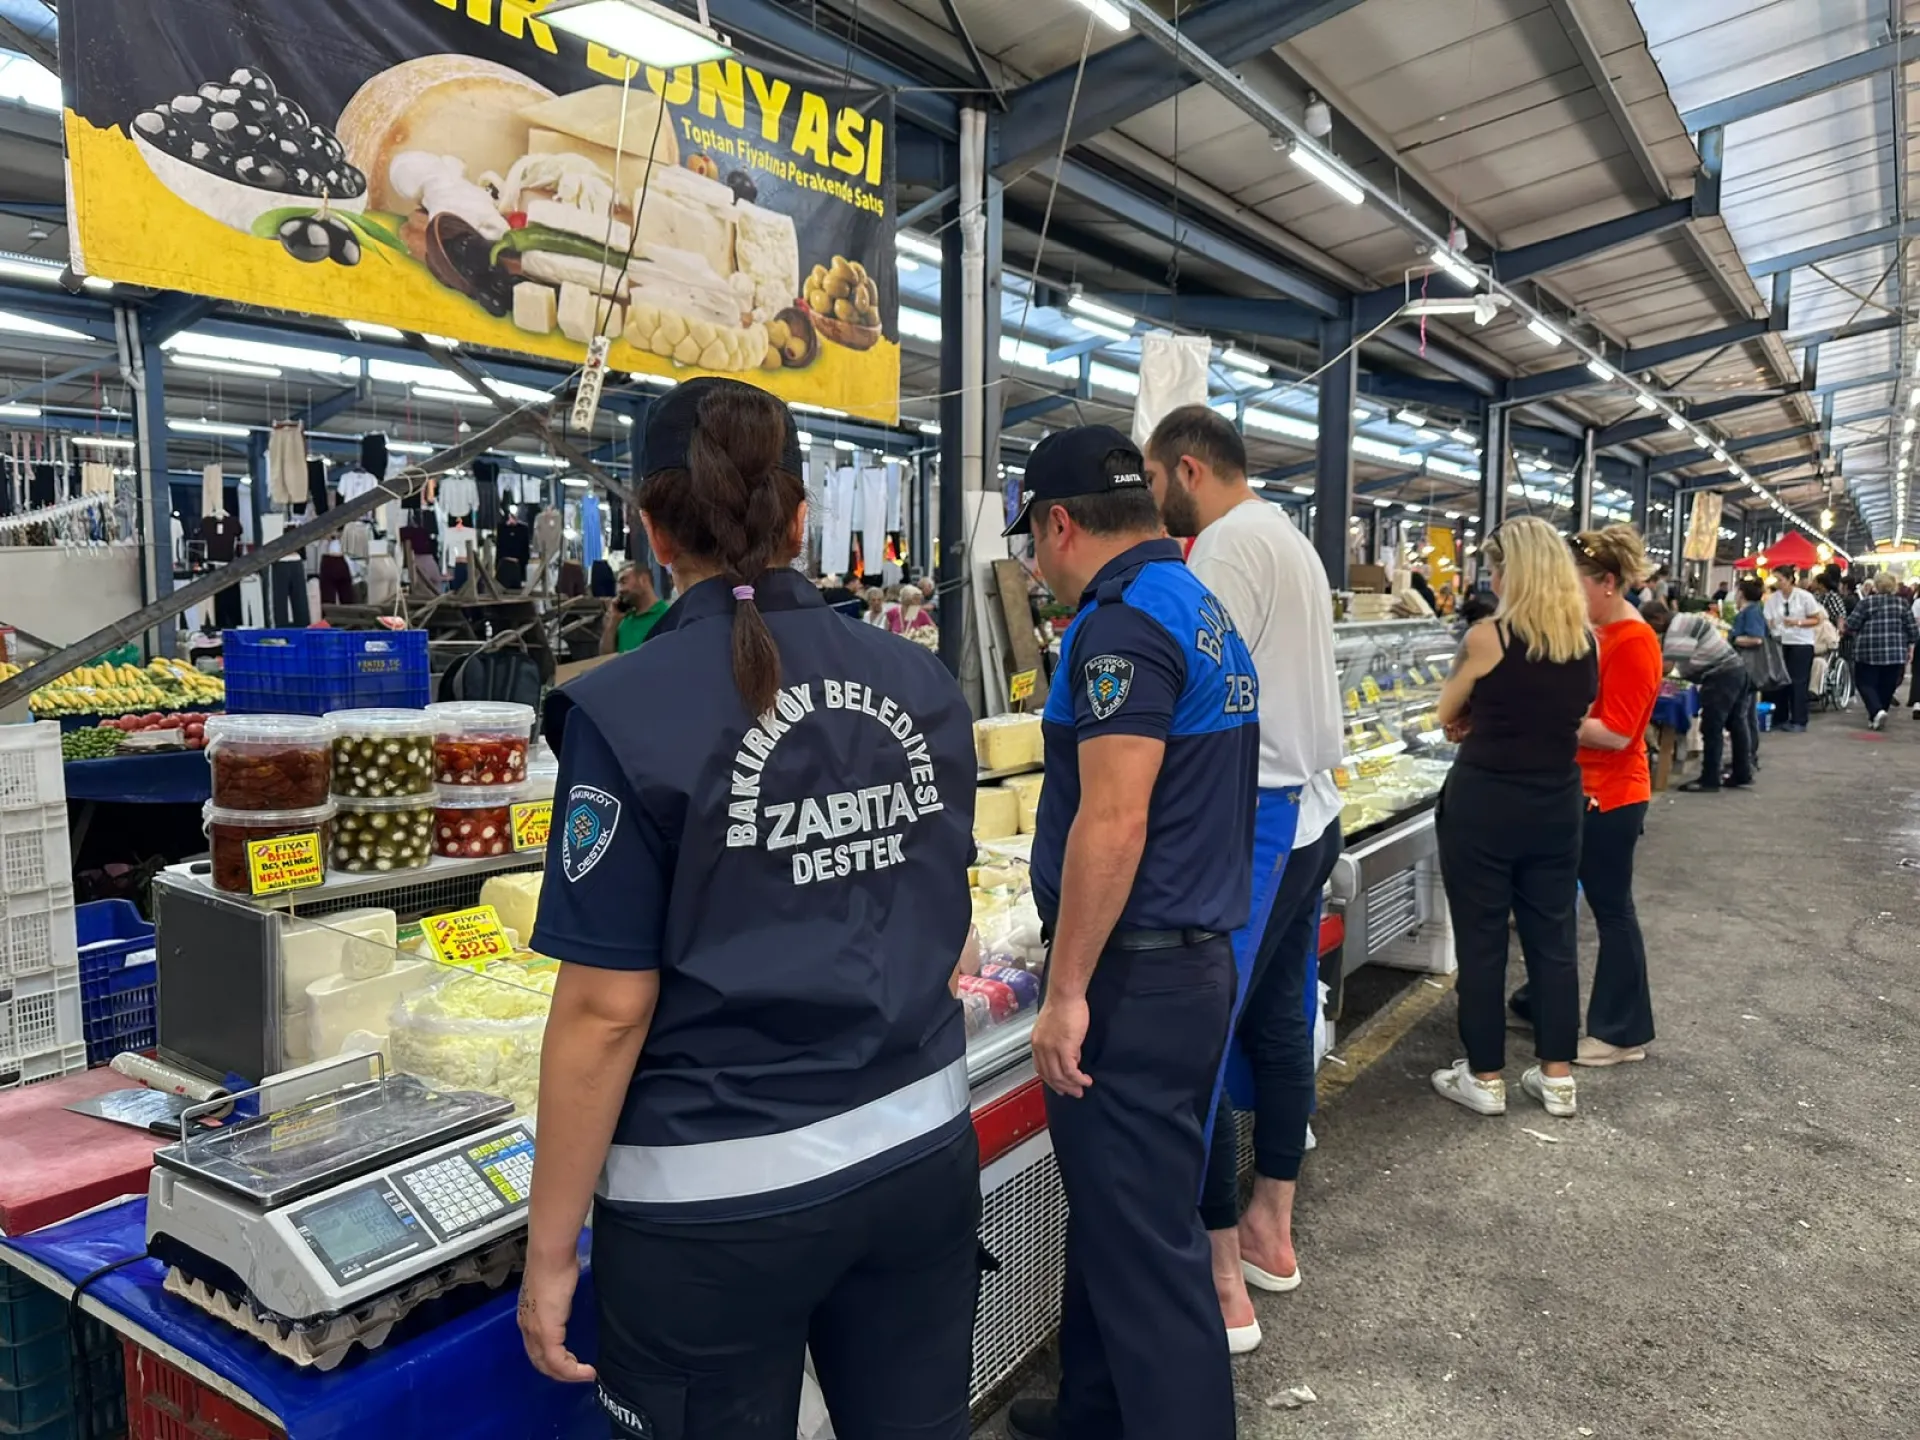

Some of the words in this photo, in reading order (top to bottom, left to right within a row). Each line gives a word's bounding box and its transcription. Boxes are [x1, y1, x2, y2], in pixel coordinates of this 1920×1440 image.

[681, 116, 734, 156] Toptan
[787, 160, 853, 205] Perakende
[726, 683, 815, 848] BAKIRKÖY
[764, 782, 918, 850] ZABITA
[577, 827, 611, 872] DESTEK
[792, 833, 906, 885] DESTEK
[455, 938, 500, 960] 325
